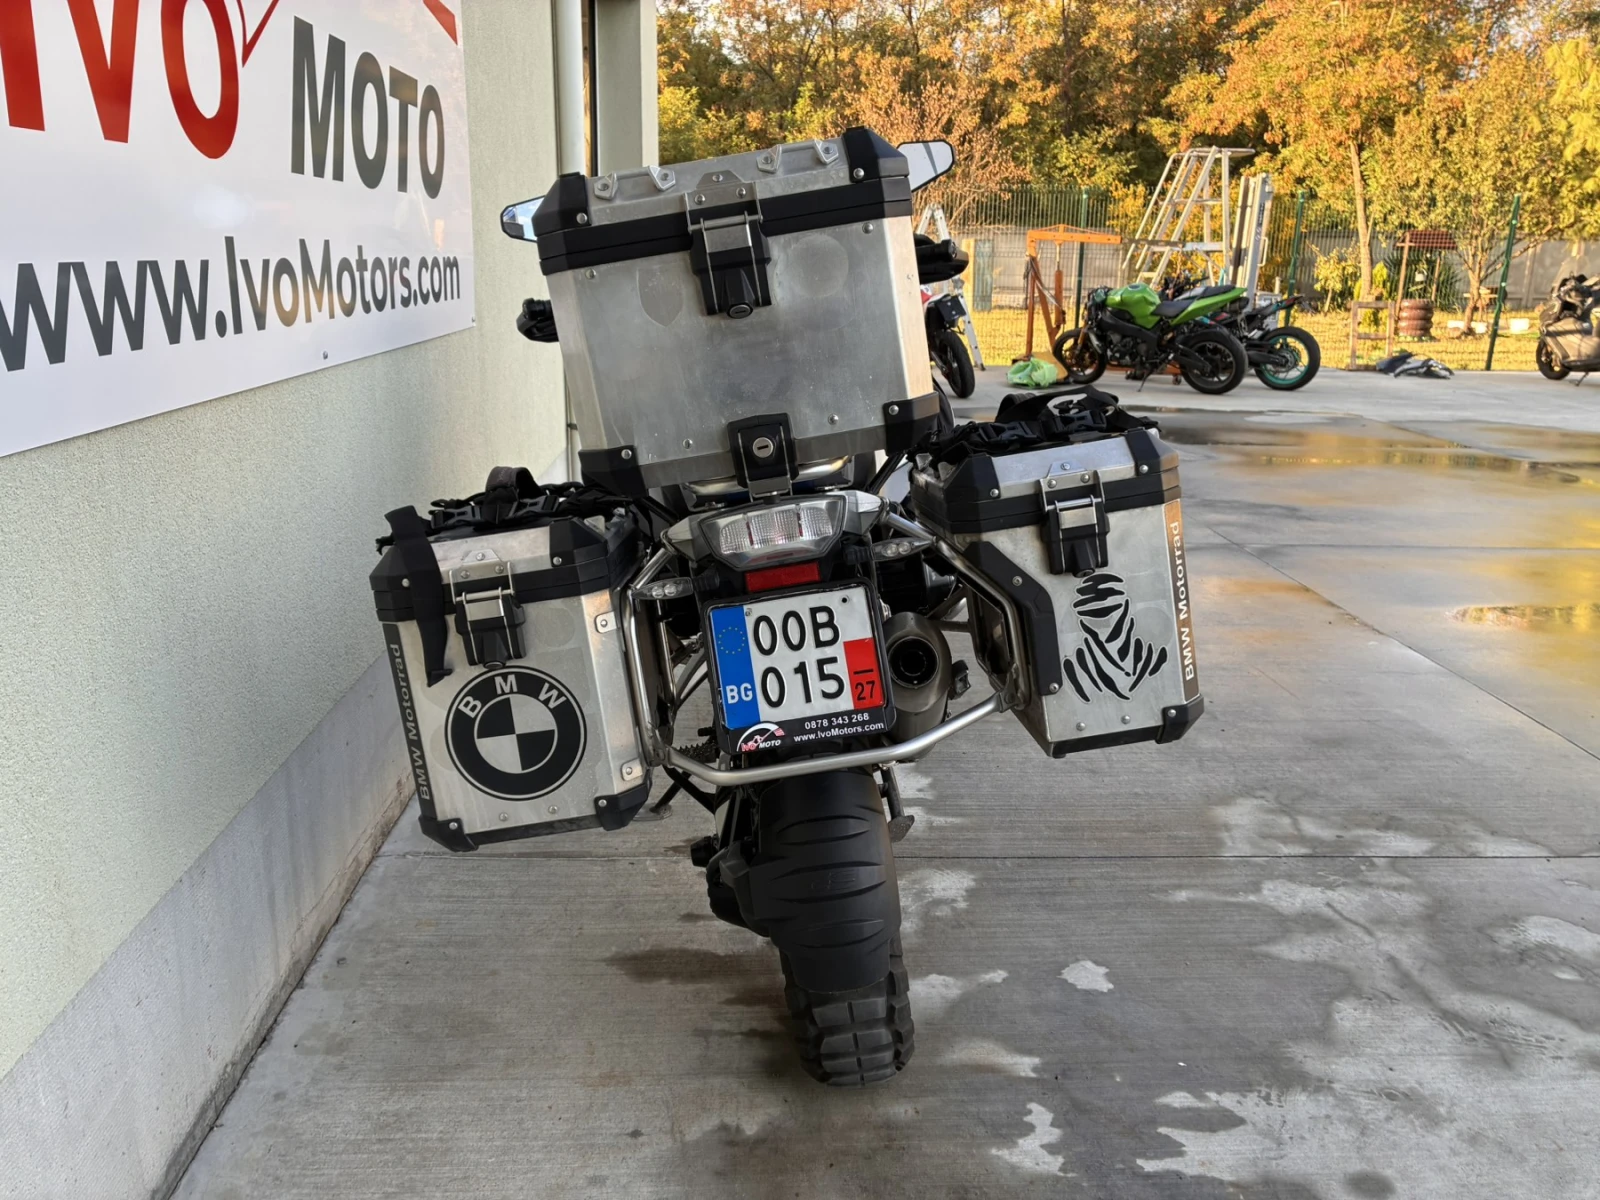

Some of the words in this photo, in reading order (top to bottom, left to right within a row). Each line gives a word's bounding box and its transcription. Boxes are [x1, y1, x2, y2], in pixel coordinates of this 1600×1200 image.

[291, 15, 445, 199] MOTO
[0, 236, 461, 372] www.IvoMotors.com
[1169, 521, 1188, 620] Motorrad
[1180, 627, 1195, 681] BMW
[390, 644, 418, 741] Motorrad
[458, 674, 566, 718] BMW
[725, 683, 753, 704] BG
[761, 656, 845, 708] 015
[854, 680, 876, 701] 27
[758, 739, 781, 749] MOTO
[793, 722, 884, 742] www.IvoMotors.com
[804, 718, 829, 730] 0878
[831, 715, 849, 726] 343
[851, 712, 870, 723] 268
[411, 747, 430, 800] BMW
